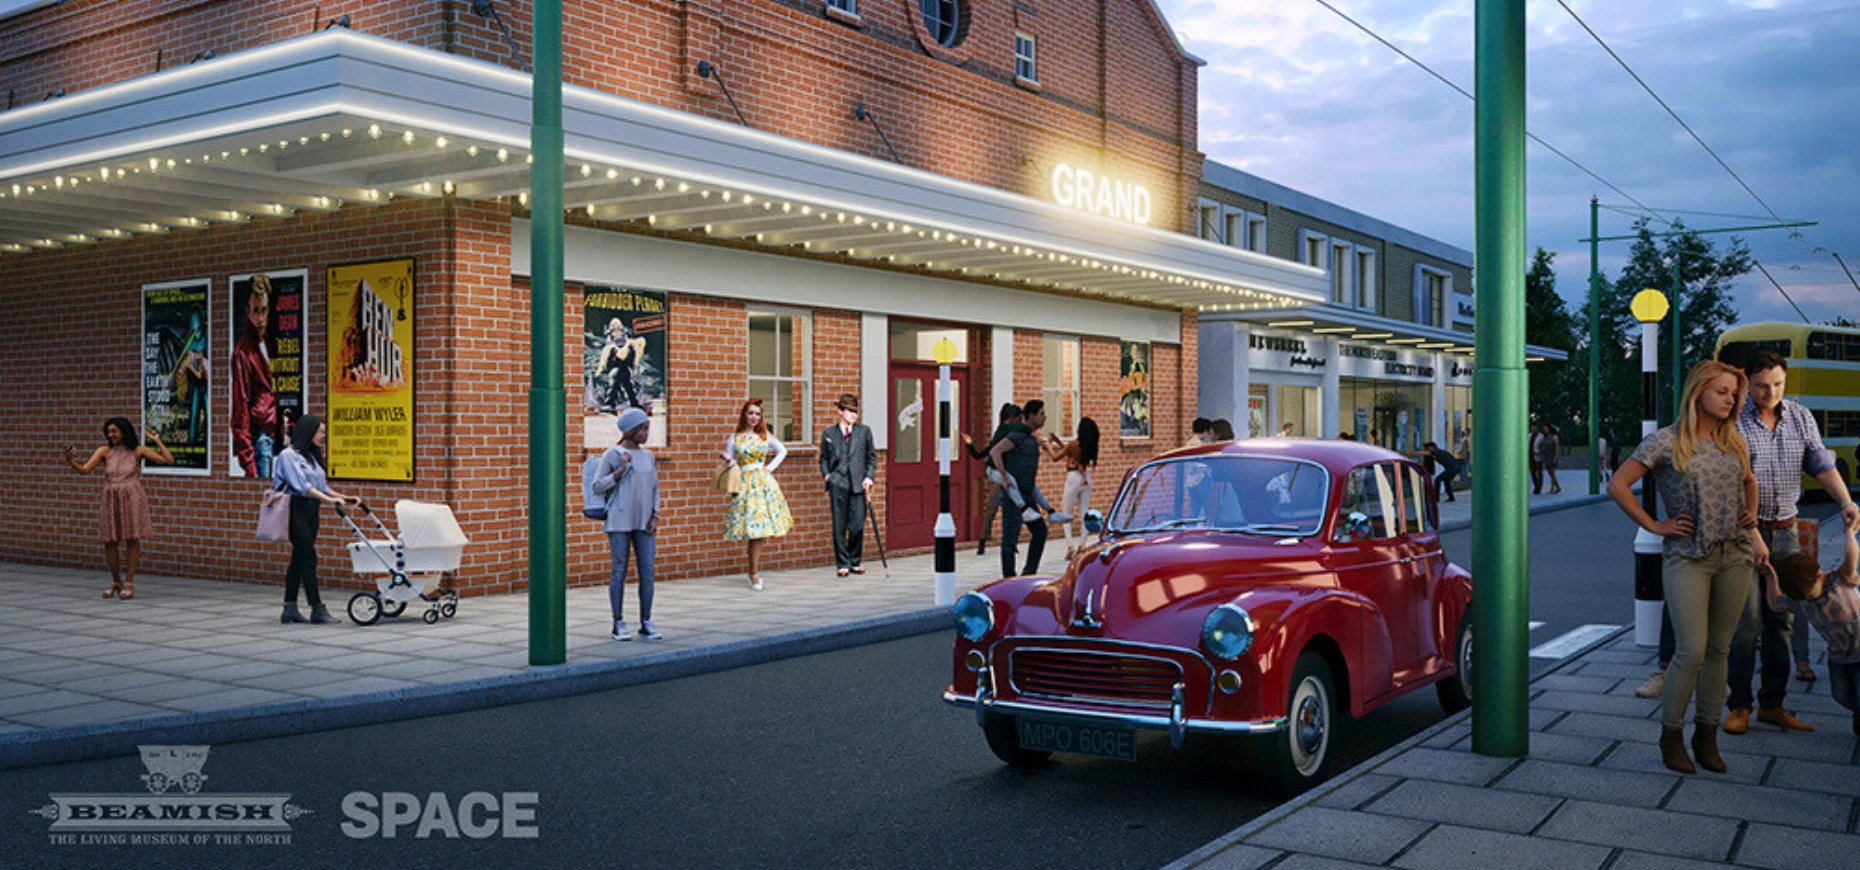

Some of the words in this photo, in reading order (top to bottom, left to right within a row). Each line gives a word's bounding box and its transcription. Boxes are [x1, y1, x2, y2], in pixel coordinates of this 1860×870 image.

[1052, 163, 1152, 225] GRAND
[1249, 334, 1307, 353] NEWSREEL
[1024, 722, 1072, 750] MPO
[1080, 728, 1130, 757] 606E
